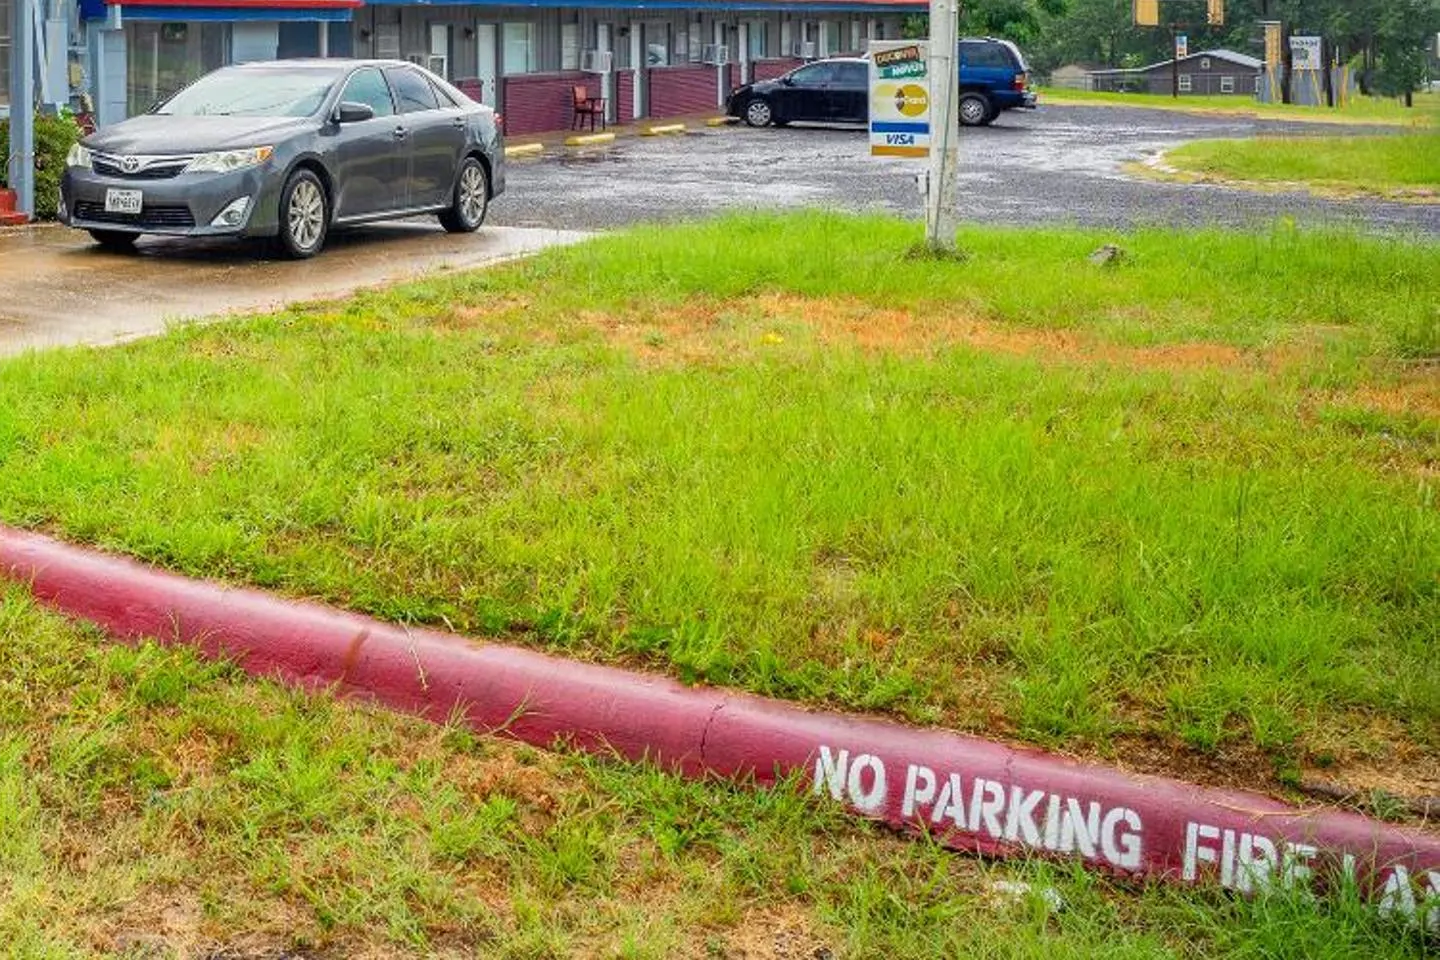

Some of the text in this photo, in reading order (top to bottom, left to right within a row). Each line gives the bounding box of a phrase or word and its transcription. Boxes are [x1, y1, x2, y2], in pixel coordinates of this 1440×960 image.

[886, 133, 915, 145] VISA
[812, 745, 886, 811] NO
[901, 763, 1143, 868] PARKING
